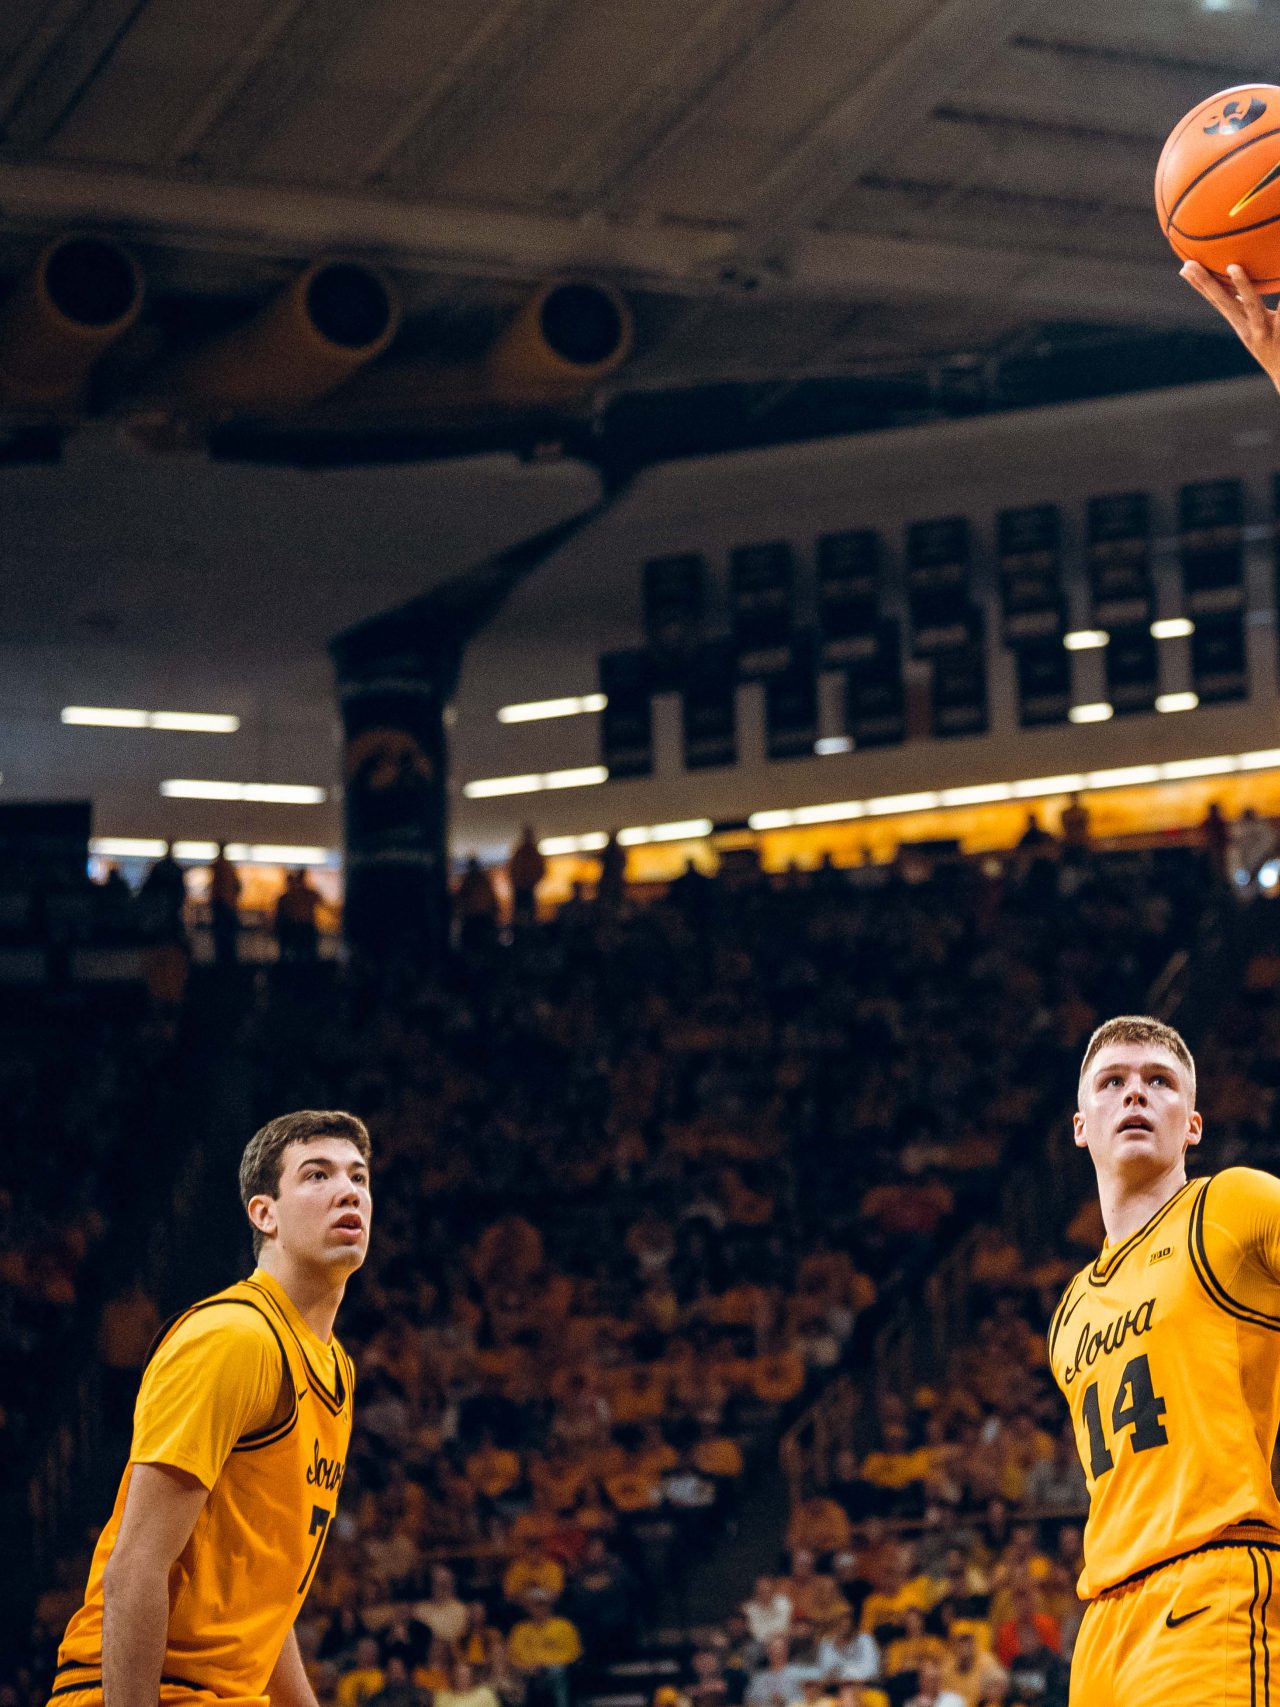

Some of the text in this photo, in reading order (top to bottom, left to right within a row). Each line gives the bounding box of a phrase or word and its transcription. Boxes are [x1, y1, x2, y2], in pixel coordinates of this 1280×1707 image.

[1065, 1298, 1157, 1385] Iowa
[1081, 1353, 1169, 1482] 14
[296, 1504, 331, 1594] 7
